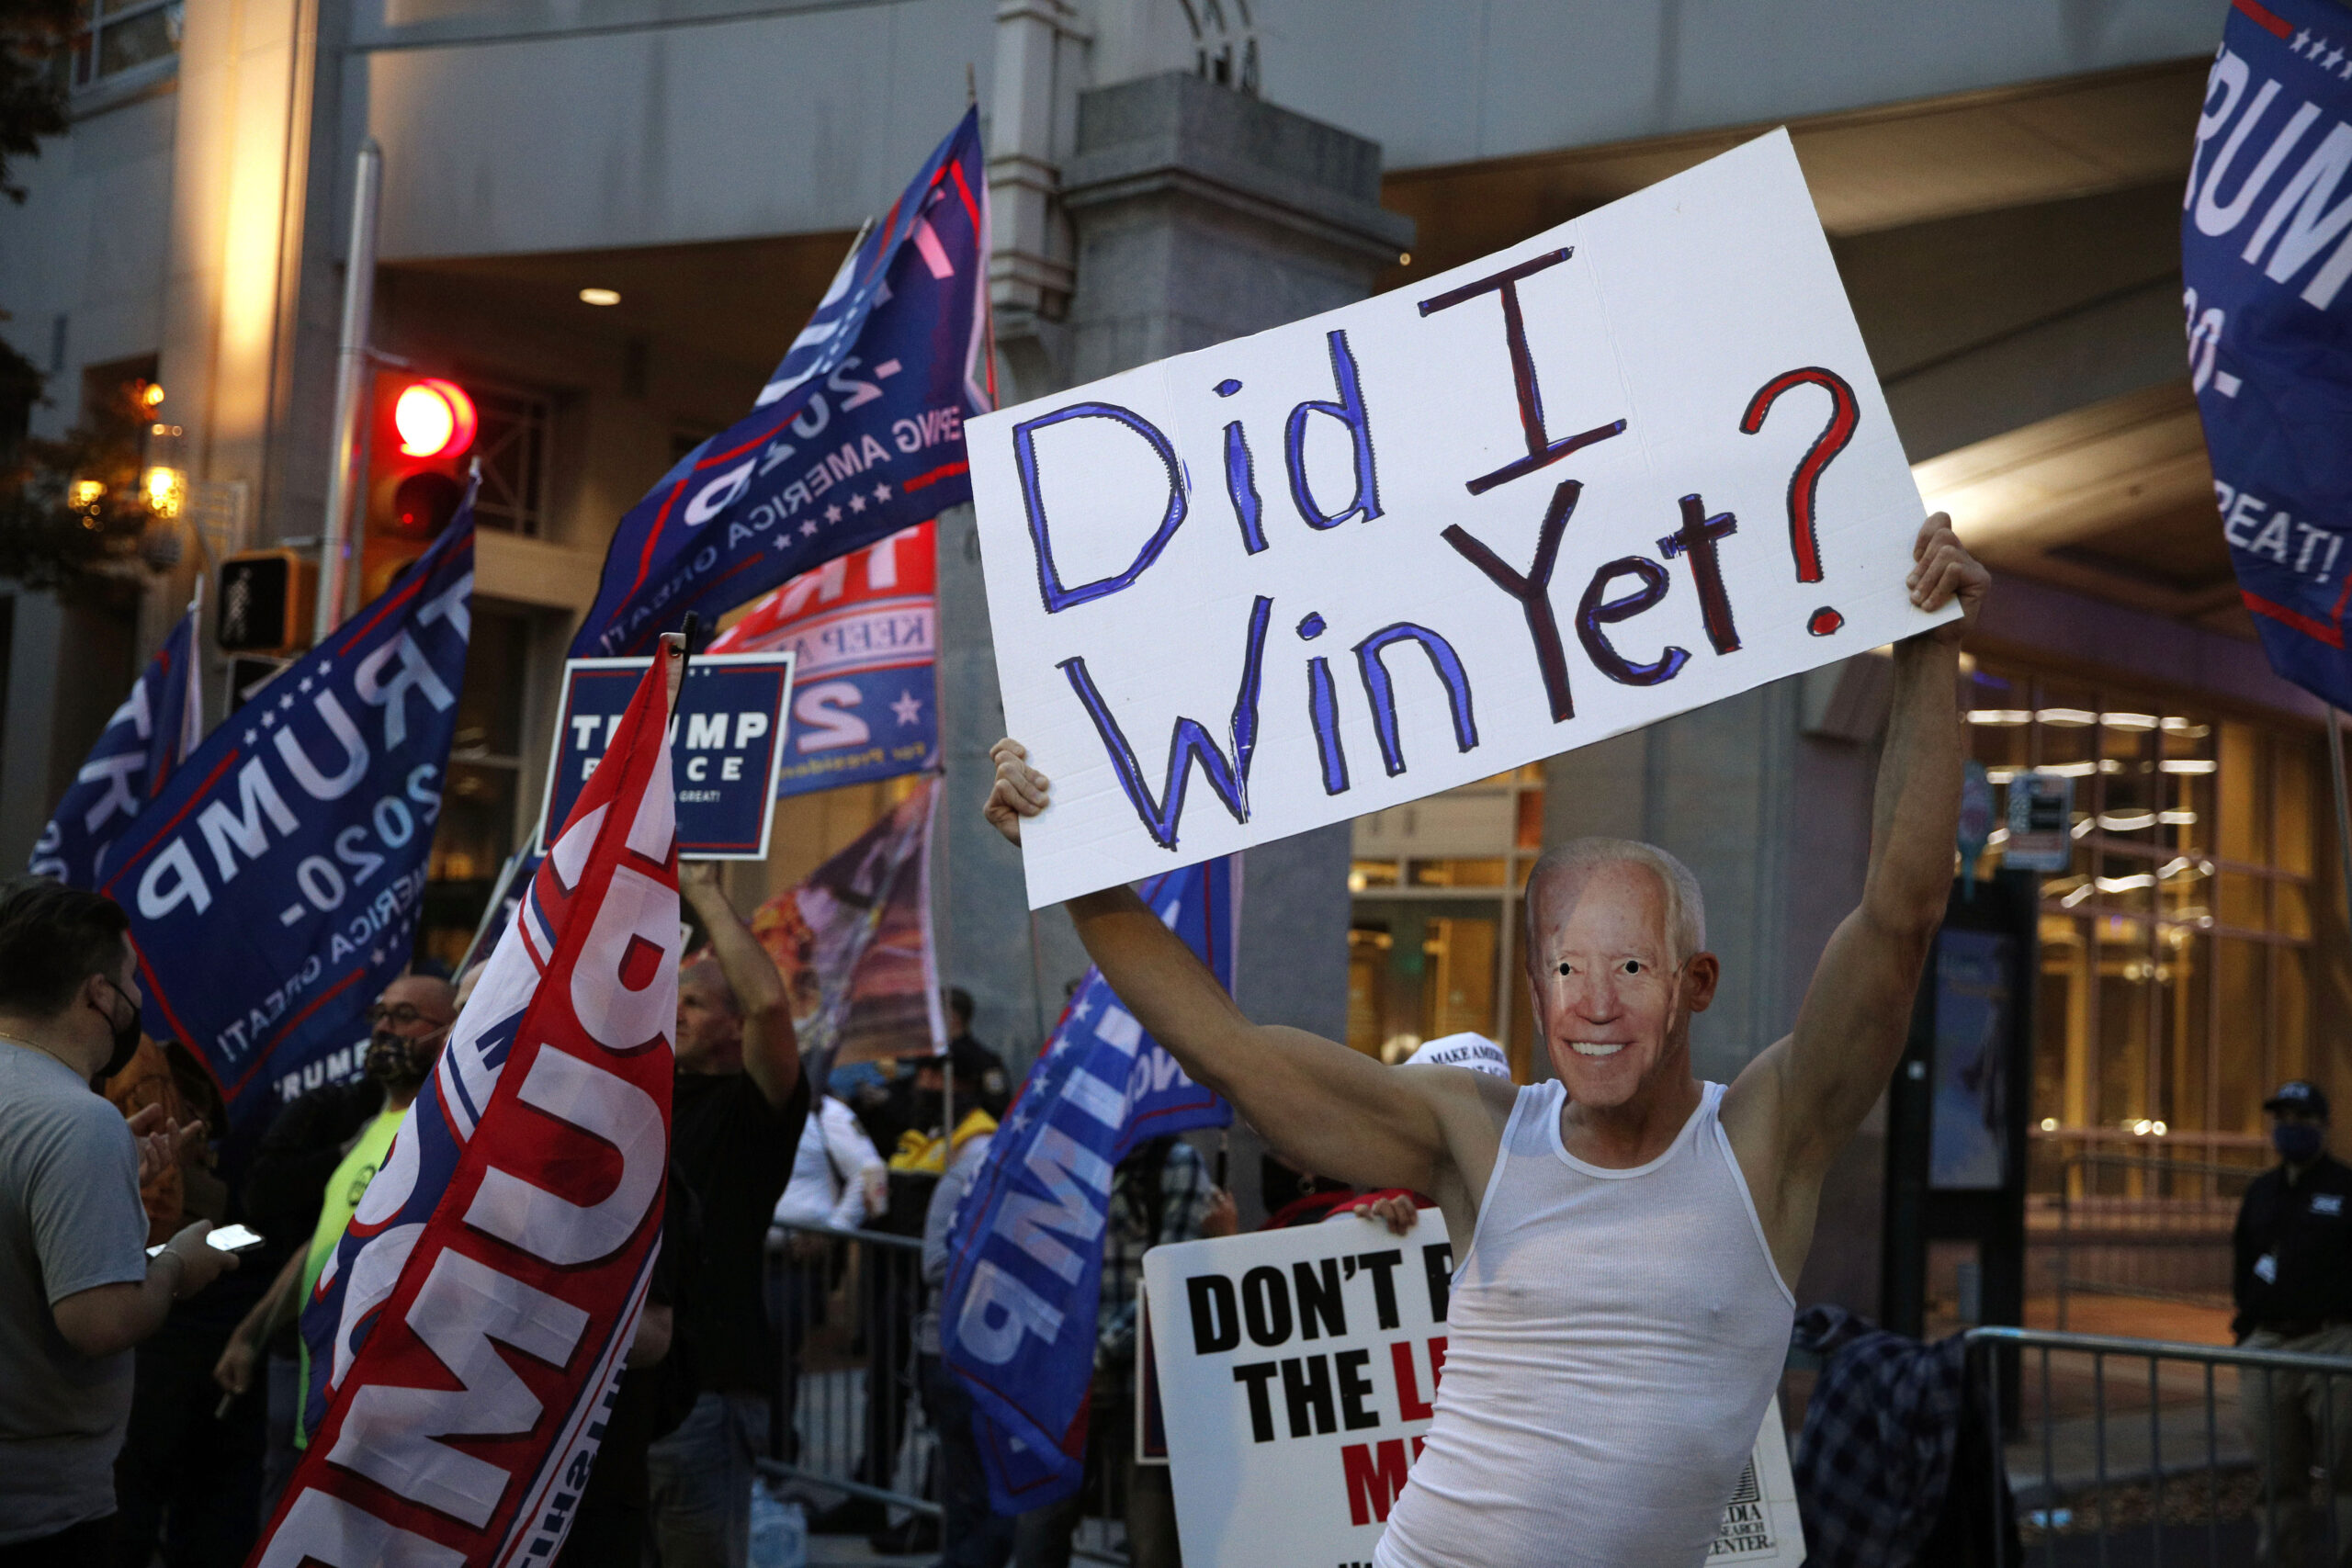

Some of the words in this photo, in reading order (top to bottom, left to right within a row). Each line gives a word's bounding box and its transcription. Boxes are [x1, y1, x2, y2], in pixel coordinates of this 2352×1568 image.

[2183, 41, 2352, 310] RUM
[1012, 330, 1385, 615] Did
[1418, 246, 1629, 496] I
[1056, 595, 1479, 852] Win
[1441, 367, 1860, 723] Yet?
[571, 712, 768, 751] TMP
[582, 756, 743, 782] PCE
[273, 1038, 372, 1101] RUMP
[1186, 1249, 1403, 1355] DON'T
[1233, 1348, 1380, 1443] THE
[1709, 1535, 1769, 1554] ENTER
[1726, 1504, 1762, 1522] DIA
